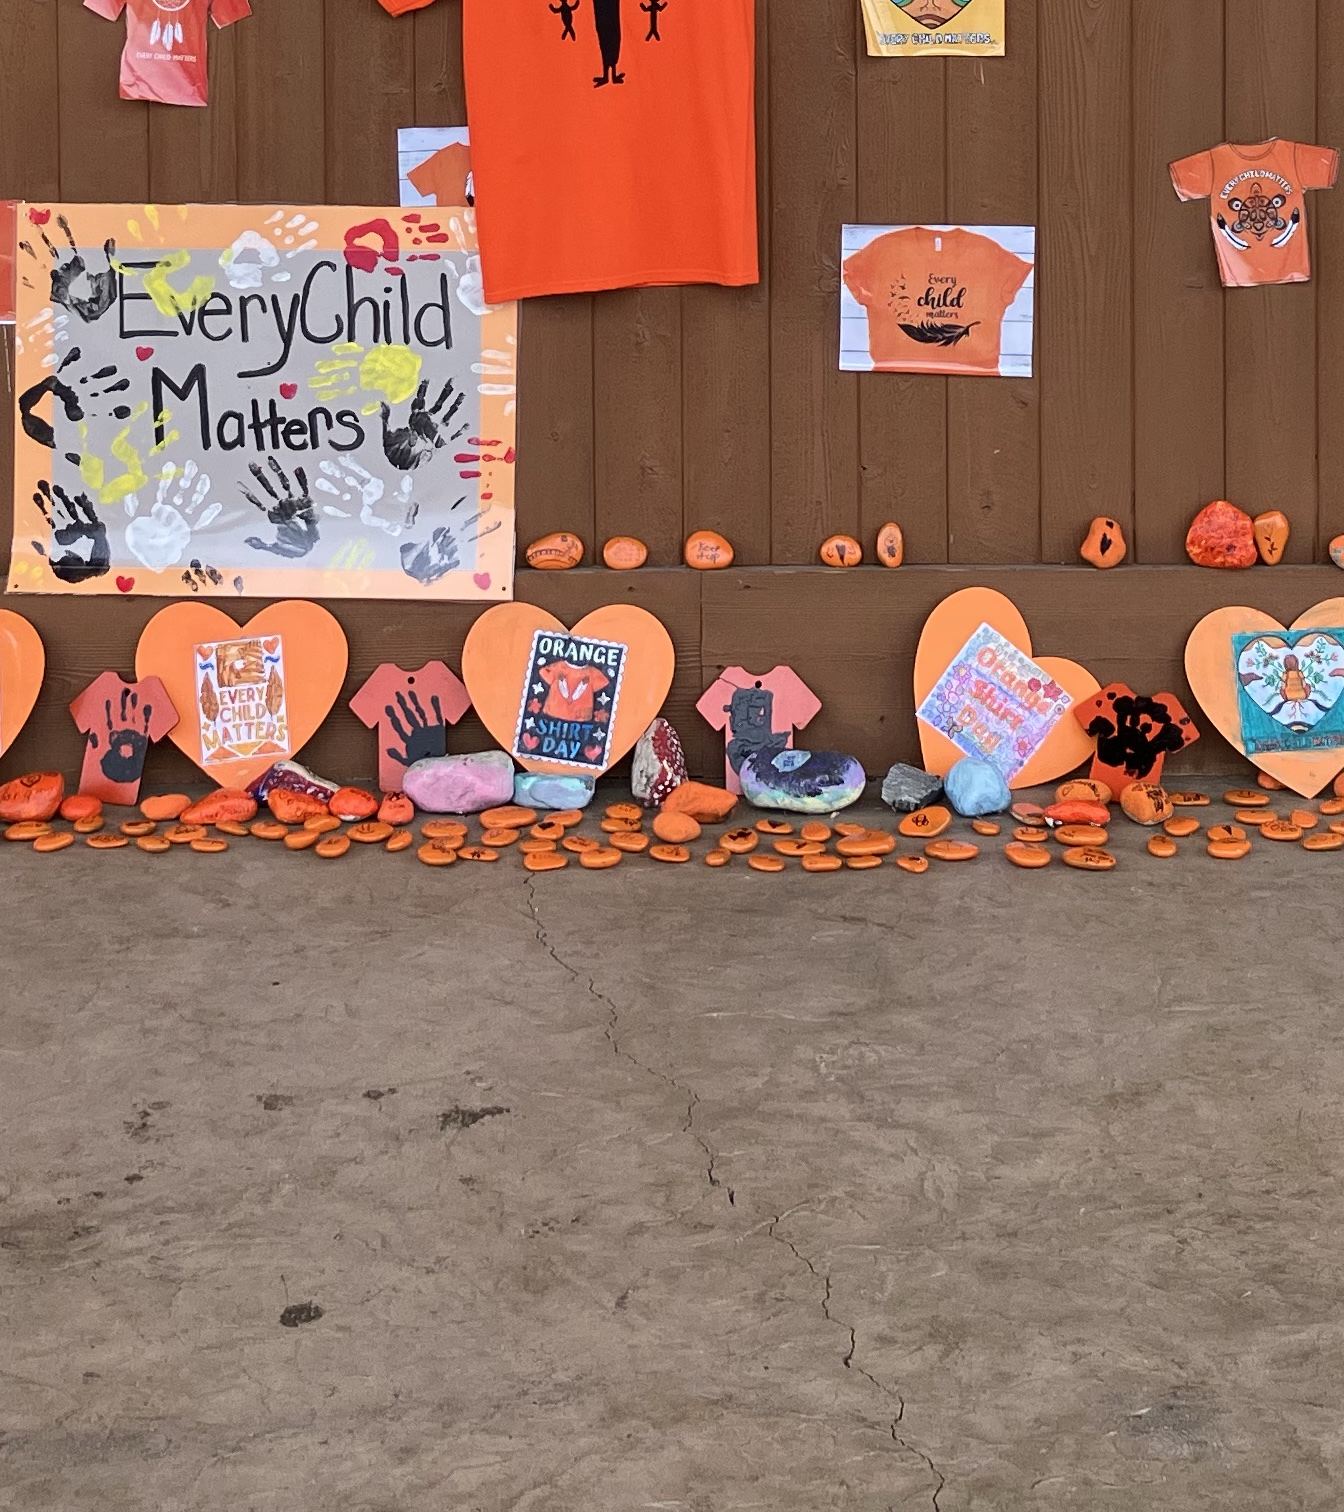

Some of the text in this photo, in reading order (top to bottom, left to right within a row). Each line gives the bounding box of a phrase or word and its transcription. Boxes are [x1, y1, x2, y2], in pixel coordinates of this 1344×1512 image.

[928, 273, 957, 289] Every
[917, 287, 967, 310] child
[925, 309, 959, 320] matters
[150, 363, 366, 452] Matters
[538, 638, 620, 666] ORANGE
[977, 647, 1051, 715] Orange
[219, 686, 265, 705] EVERY
[969, 679, 1025, 731] Shirt
[219, 703, 267, 723] CHILD
[202, 721, 288, 751] MATTERS
[536, 719, 594, 741] SHIRT
[956, 704, 1002, 754] Day
[542, 737, 582, 759] DAY
